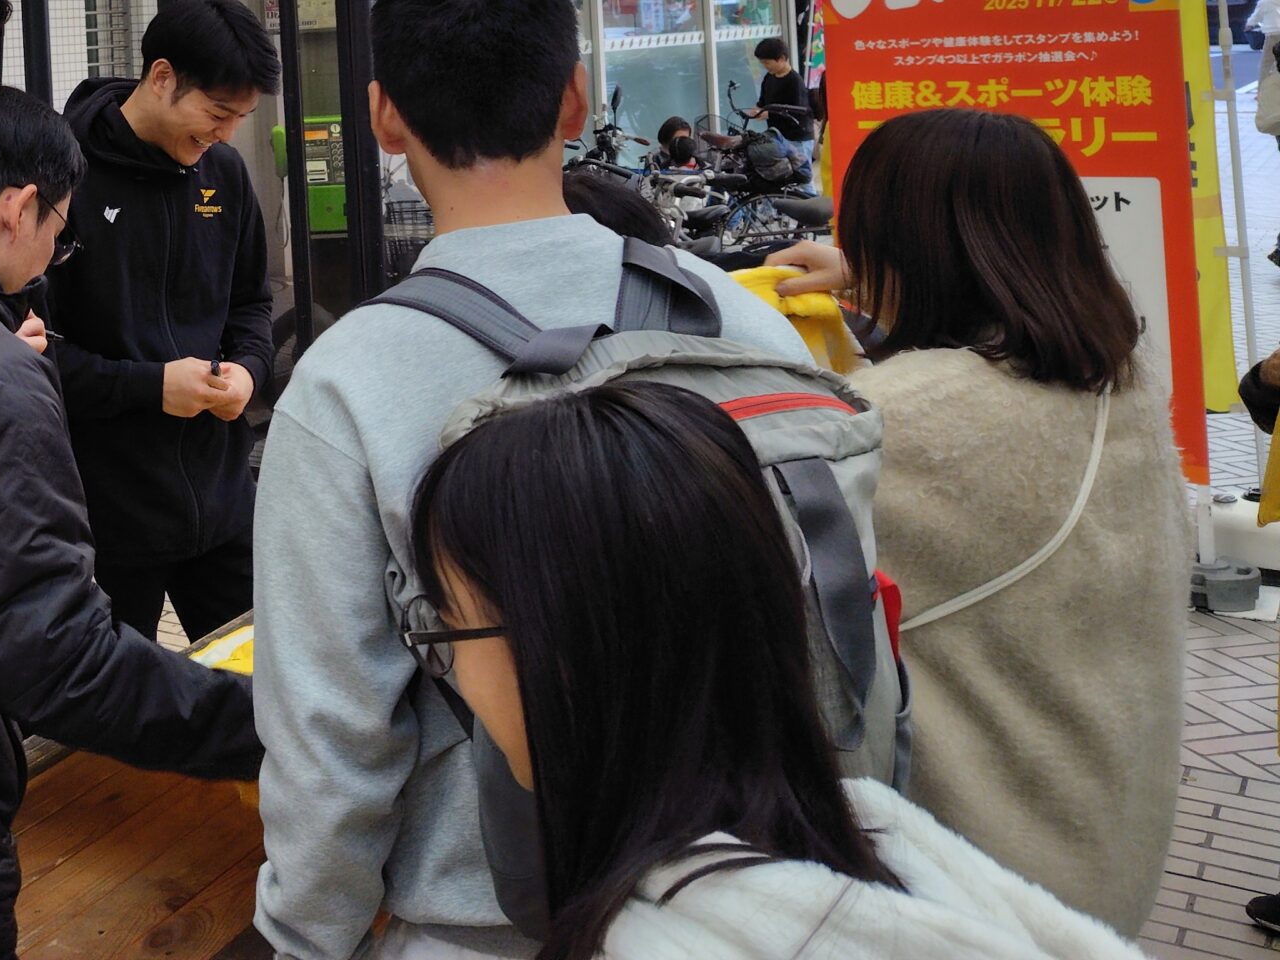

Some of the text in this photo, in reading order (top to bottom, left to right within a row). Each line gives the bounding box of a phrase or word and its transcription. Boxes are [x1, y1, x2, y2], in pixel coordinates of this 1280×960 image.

[851, 74, 1153, 110] 健康&スポーツ体験
